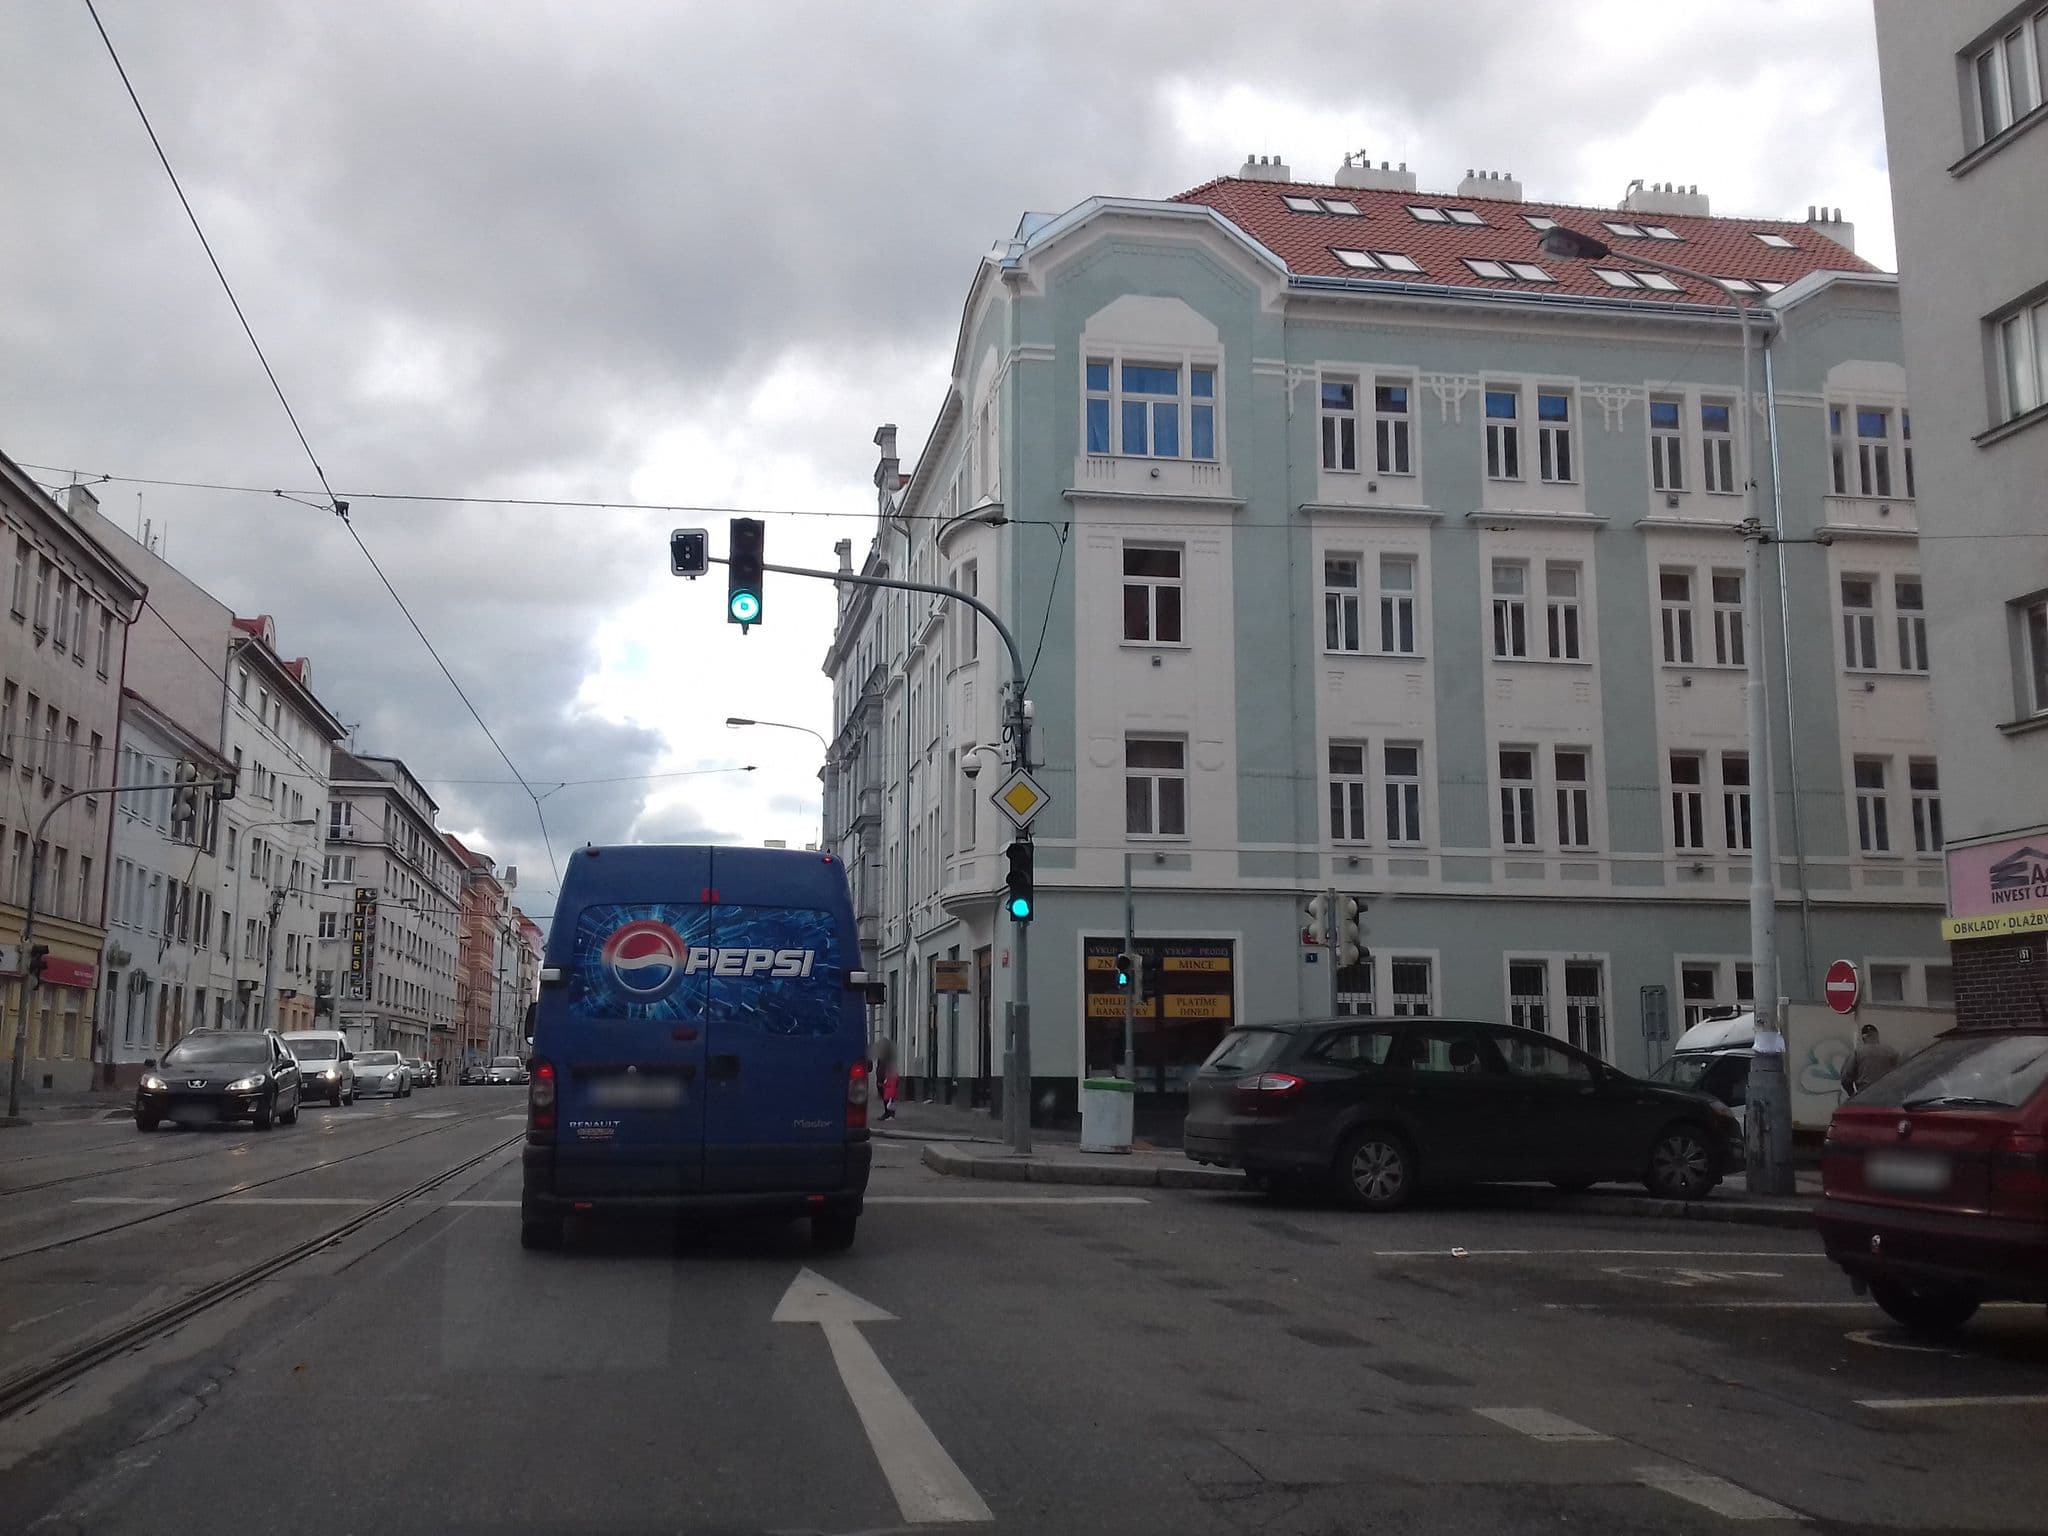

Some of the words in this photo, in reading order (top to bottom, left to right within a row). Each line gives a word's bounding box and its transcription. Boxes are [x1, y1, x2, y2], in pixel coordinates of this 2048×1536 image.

[2031, 864, 2048, 885] A
[1992, 887, 2030, 904] INVEST
[1953, 919, 2000, 934] OBKLADY
[684, 947, 815, 977] PEPSI
[1178, 959, 1215, 969] MINCE
[569, 1120, 621, 1128] RENAULT
